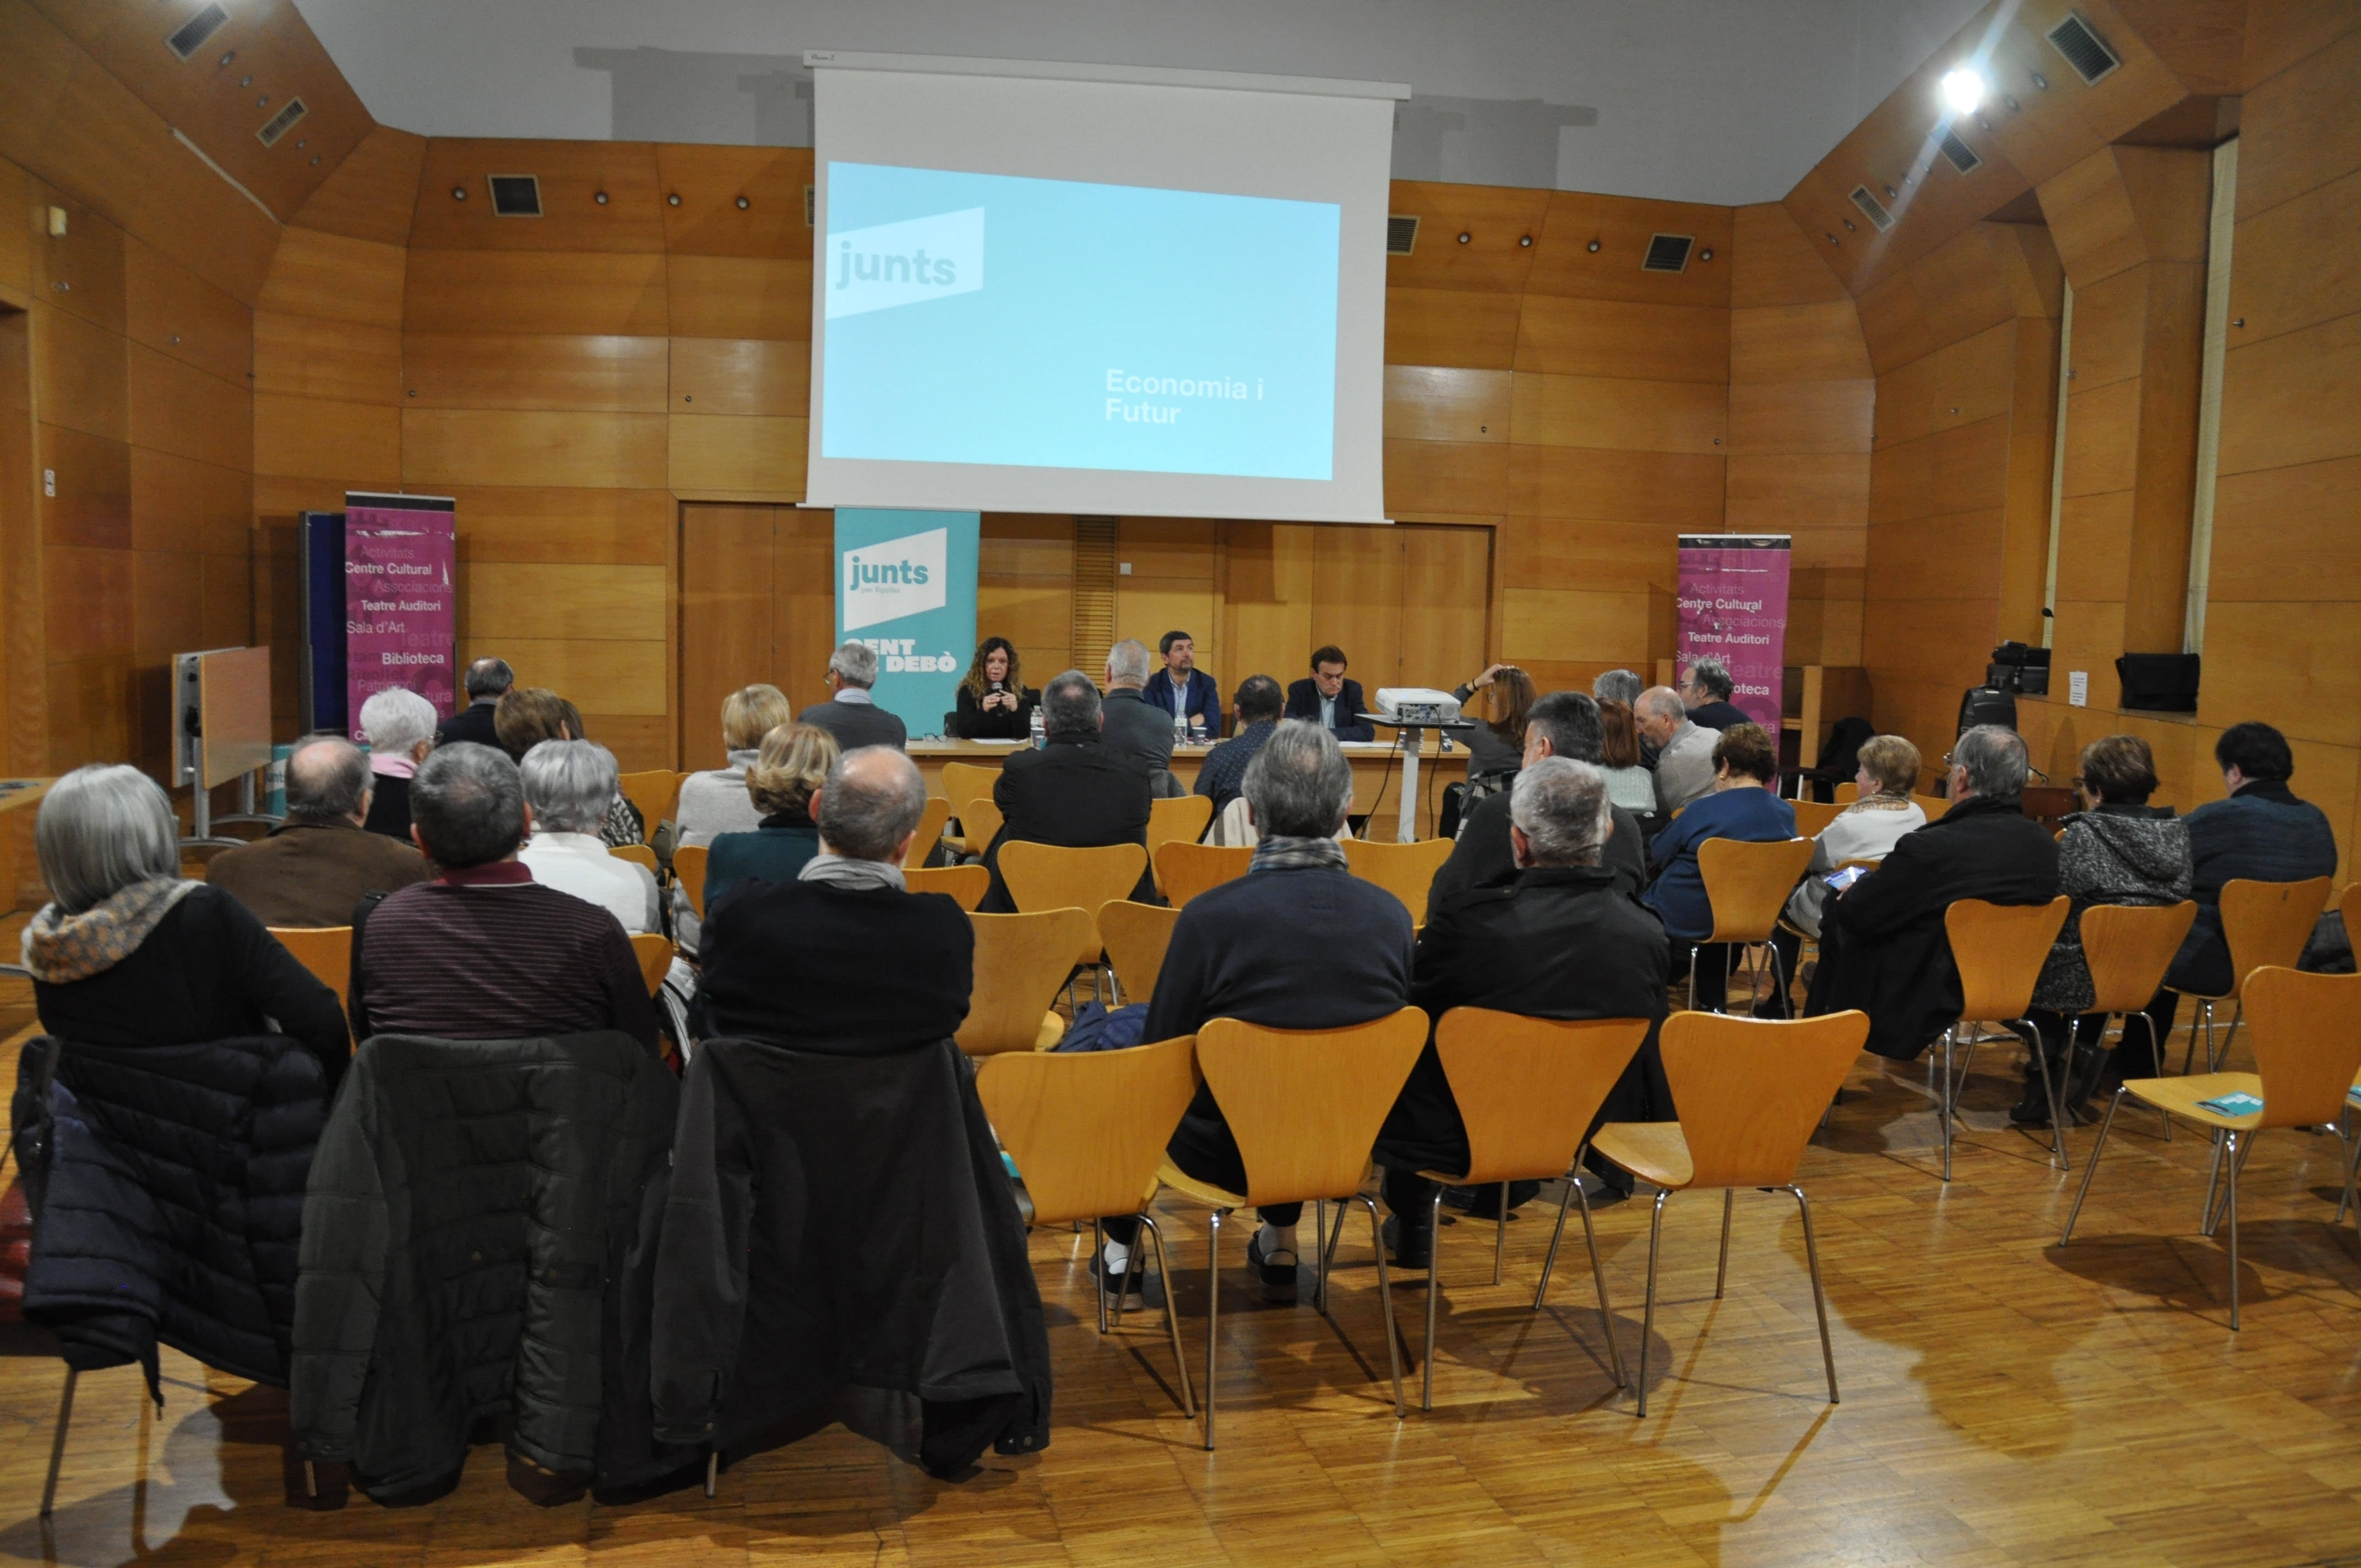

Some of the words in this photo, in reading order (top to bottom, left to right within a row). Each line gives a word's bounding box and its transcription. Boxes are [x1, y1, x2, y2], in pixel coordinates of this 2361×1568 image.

[835, 240, 956, 290] junts
[1106, 368, 1248, 400] Economia
[1256, 378, 1264, 401] i
[1105, 398, 1182, 424] Futur
[360, 546, 415, 559] Activitats
[345, 561, 384, 574] Centre
[387, 562, 432, 575] Cultural
[850, 556, 928, 591] junts
[373, 579, 453, 594] Associacions
[1690, 582, 1744, 595] Activitats
[361, 599, 395, 611] Teatre
[399, 600, 441, 612] Auditori
[1677, 597, 1712, 609] Centre
[1715, 598, 1762, 610] Cultural
[346, 620, 373, 634] Sala
[376, 621, 405, 633] d'Art
[1702, 614, 1784, 629] Associacions
[1687, 631, 1722, 643] Teatre
[1724, 633, 1770, 645] Auditori
[382, 652, 444, 665] Biblioteca
[886, 651, 957, 673] DEBÒ
[1732, 662, 1782, 679] eatre
